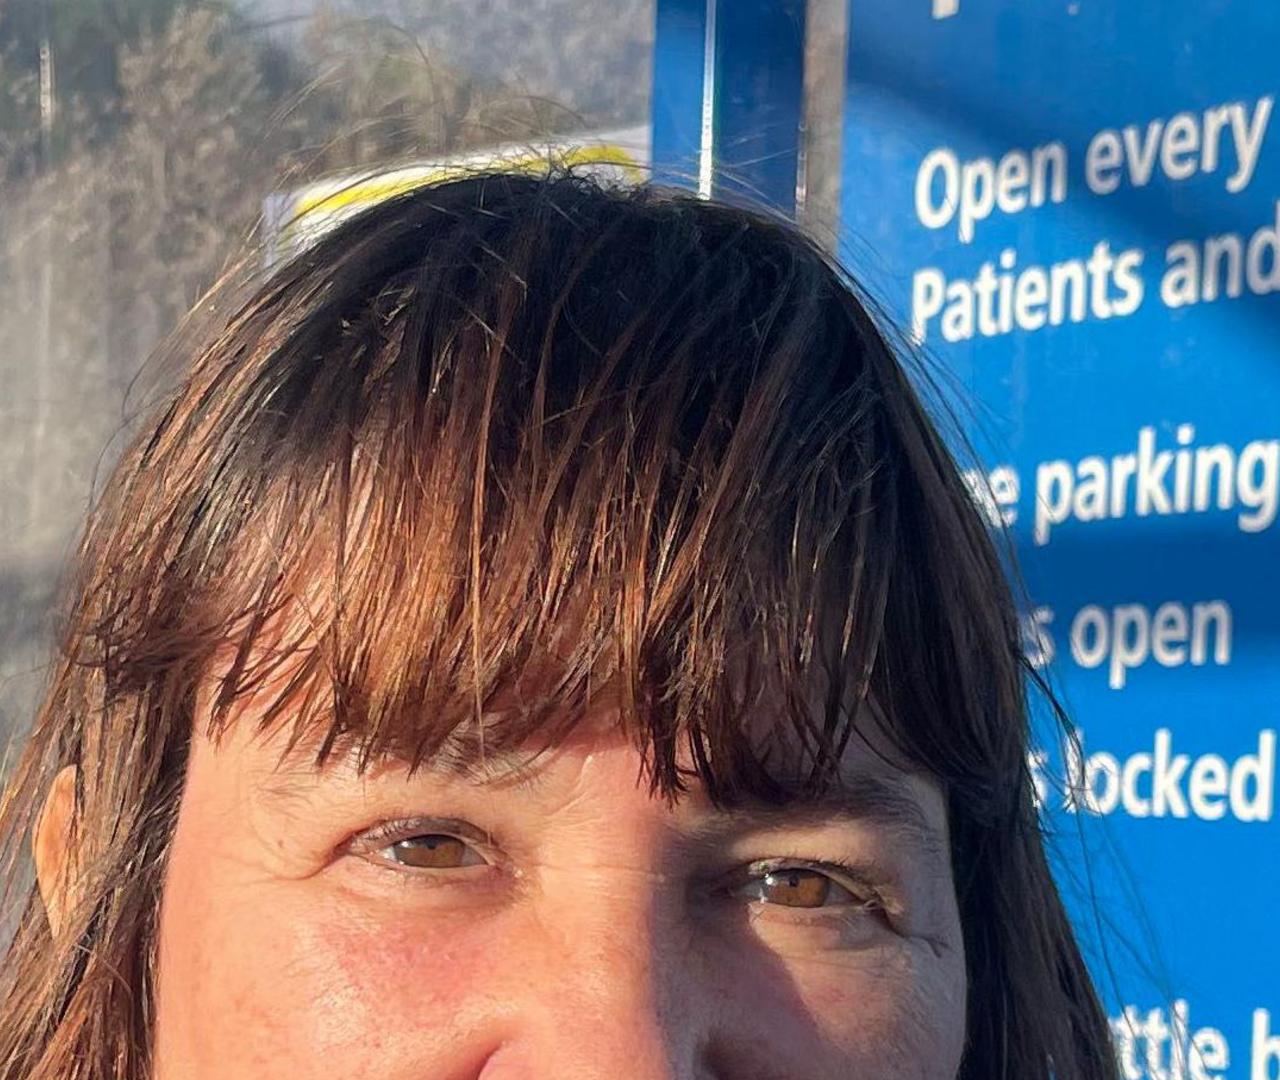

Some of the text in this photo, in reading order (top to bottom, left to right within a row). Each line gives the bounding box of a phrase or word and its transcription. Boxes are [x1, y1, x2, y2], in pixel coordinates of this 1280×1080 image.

[912, 142, 1068, 244] Open
[1085, 96, 1274, 194] every
[911, 241, 1145, 347] Patients
[1070, 600, 1233, 690] open
[1062, 727, 1277, 823] locked
